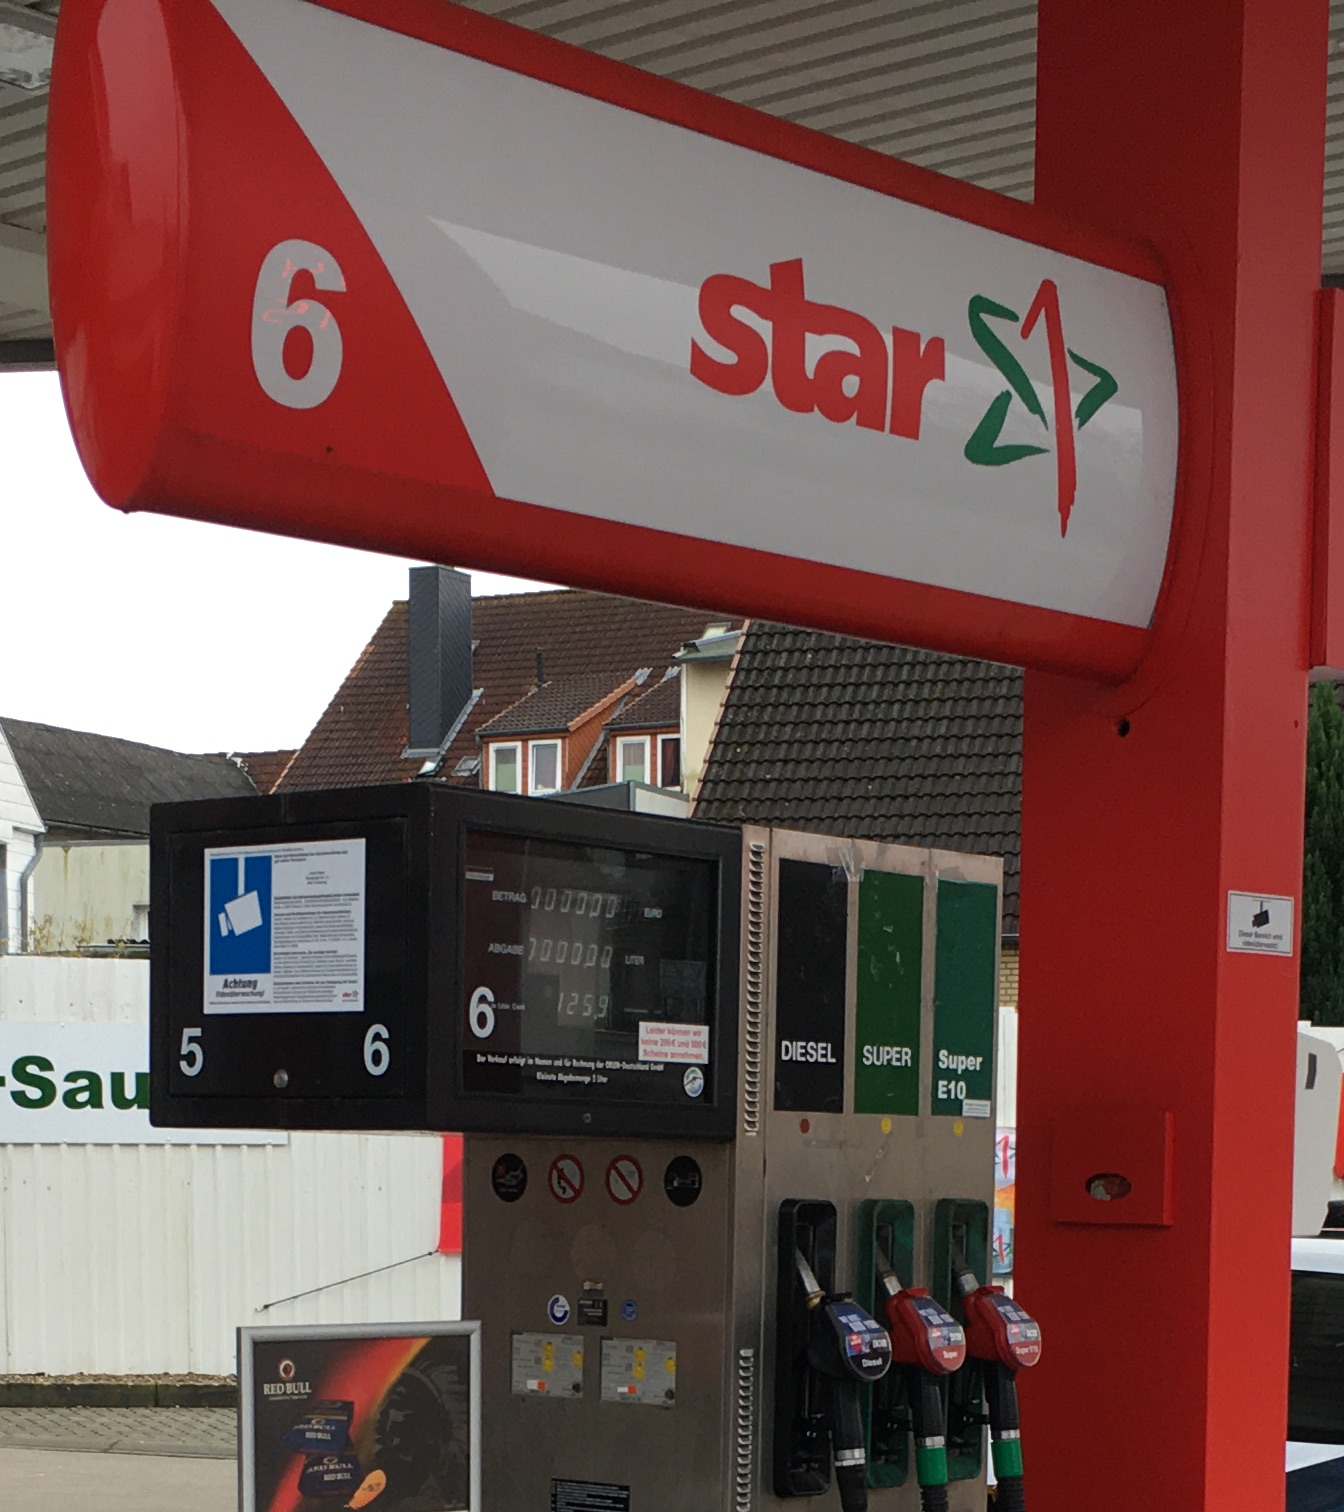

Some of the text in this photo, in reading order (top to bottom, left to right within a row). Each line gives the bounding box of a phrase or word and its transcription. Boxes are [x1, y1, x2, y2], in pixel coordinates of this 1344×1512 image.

[251, 238, 347, 409] 6
[689, 257, 945, 442] star
[492, 890, 527, 903] BETRAG
[488, 943, 525, 956] ABGABE
[223, 978, 258, 990] Achtung
[469, 986, 495, 1038] 6
[645, 1026, 666, 1035] Leider
[179, 1027, 204, 1077] 5
[363, 1023, 390, 1076] 6
[781, 1040, 837, 1063] DIESEL
[862, 1045, 912, 1067] SUPER
[938, 1050, 983, 1074] Super
[937, 1080, 966, 1100] E10
[862, 1357, 883, 1368] Diesel
[263, 1381, 312, 1395] RED BULL
